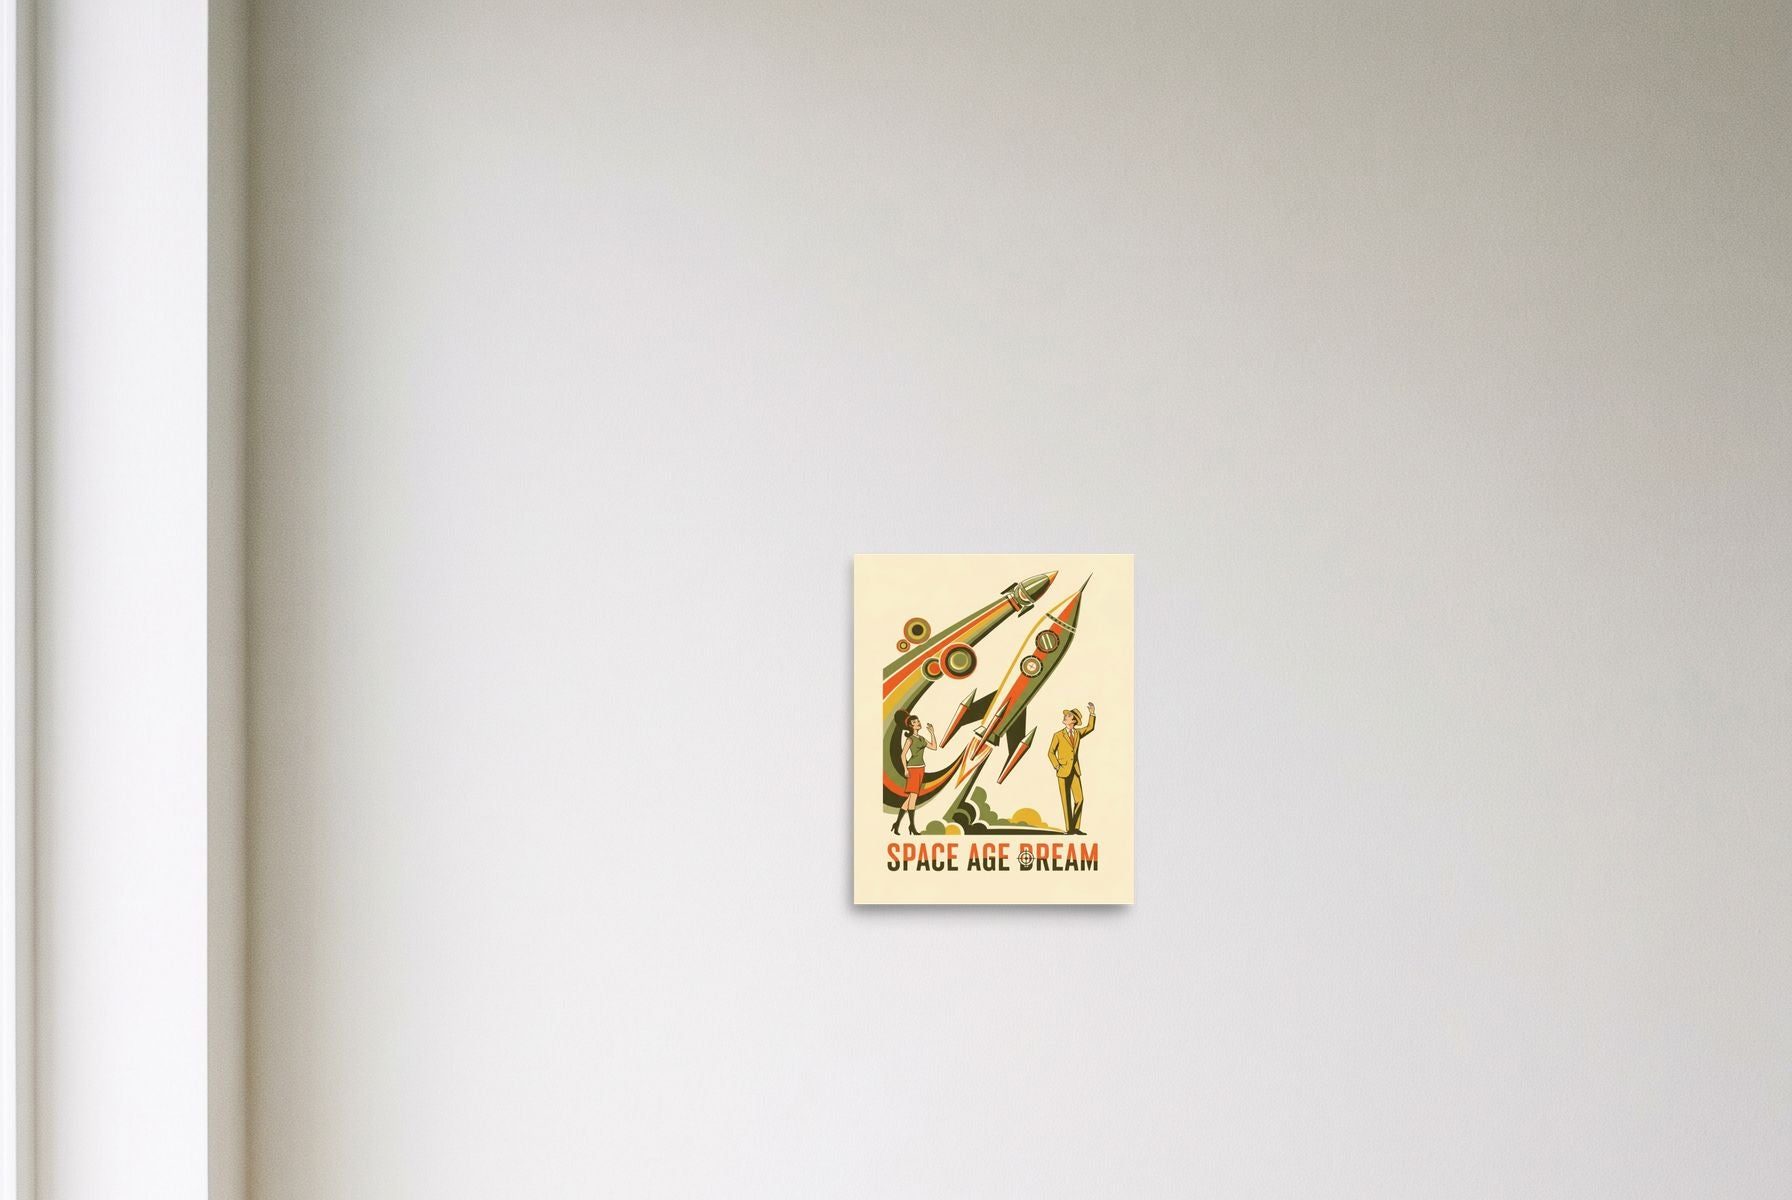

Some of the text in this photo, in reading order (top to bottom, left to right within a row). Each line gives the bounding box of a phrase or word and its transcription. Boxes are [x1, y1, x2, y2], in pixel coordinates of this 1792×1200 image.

[886, 843, 1098, 871] SPACE AGE DREAM
